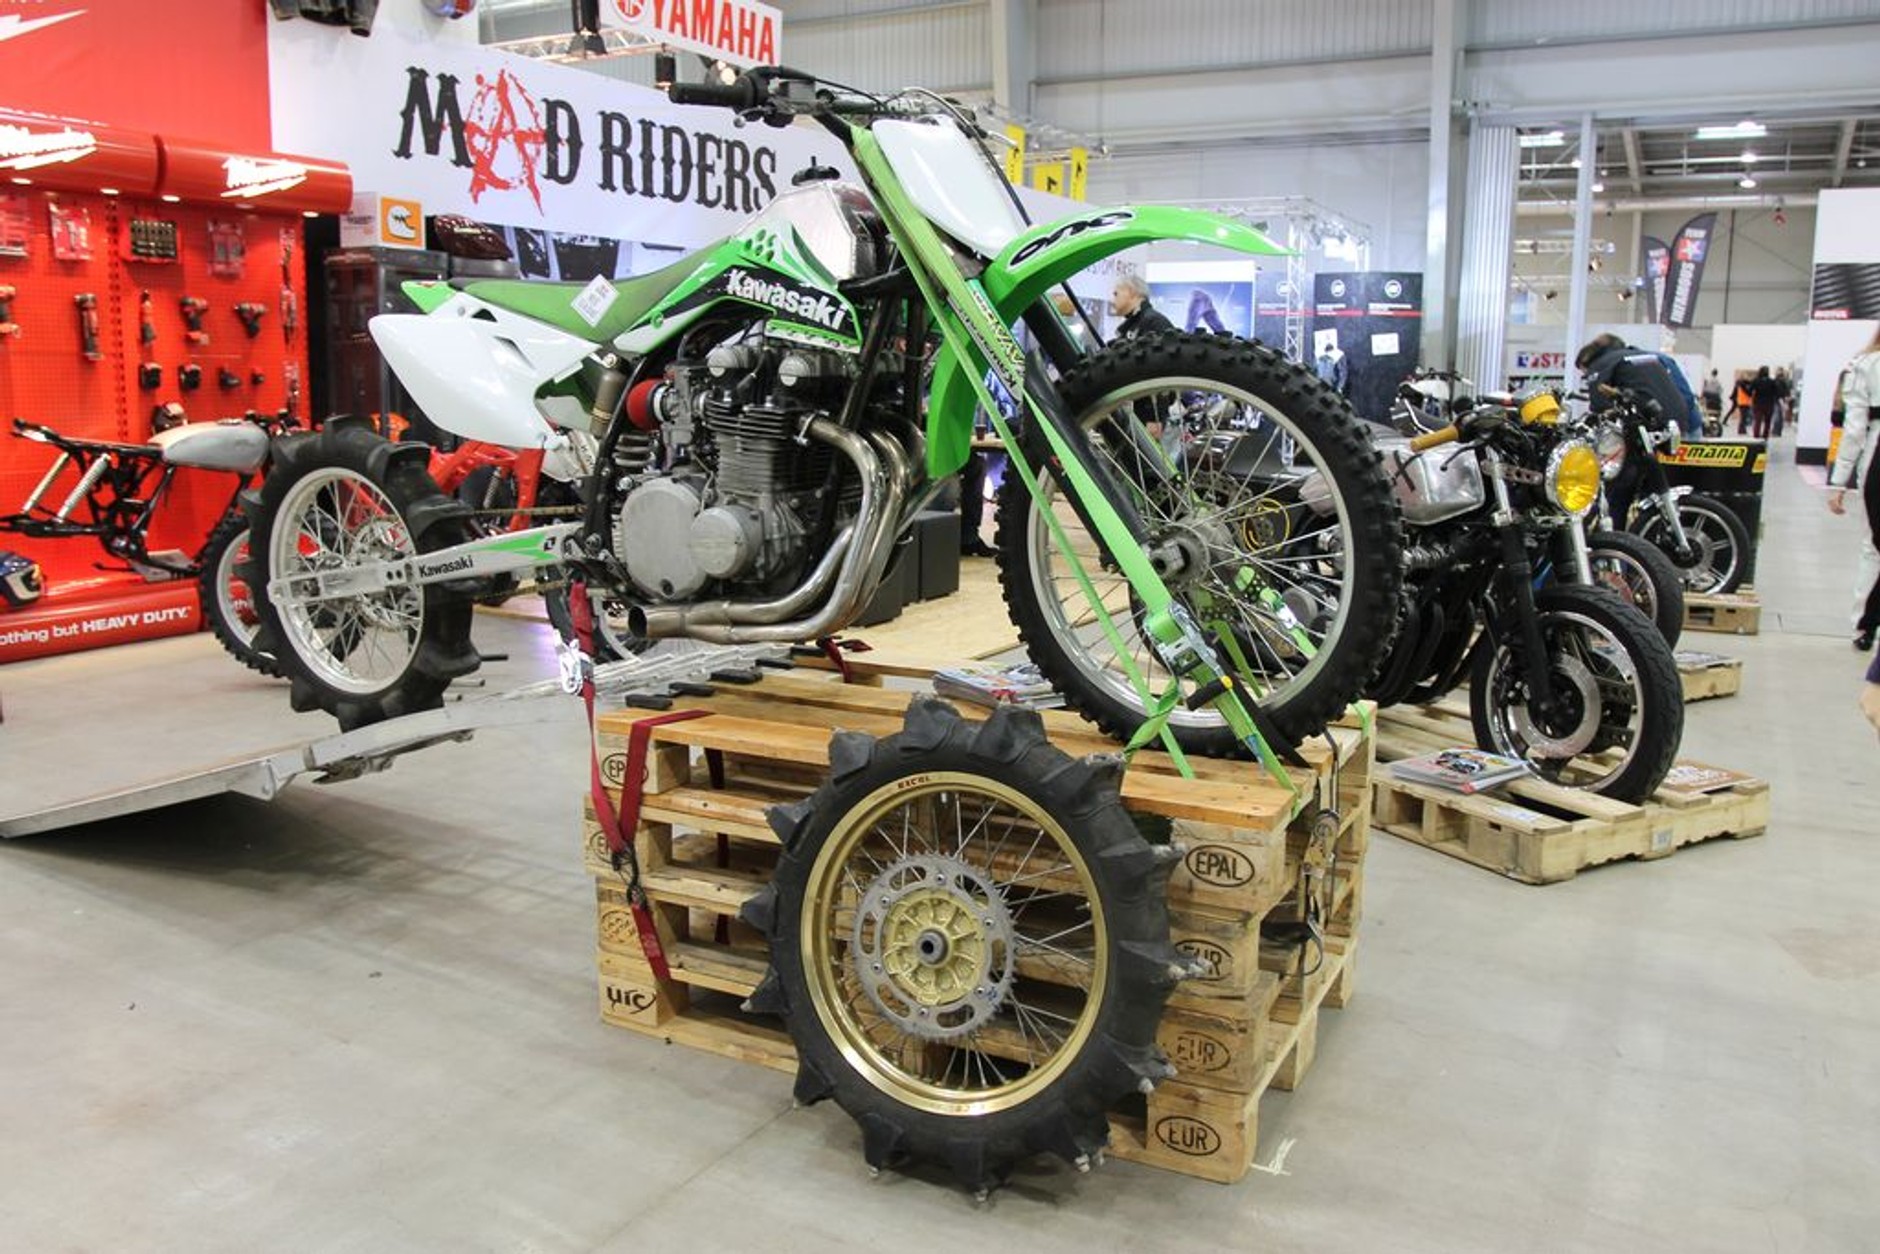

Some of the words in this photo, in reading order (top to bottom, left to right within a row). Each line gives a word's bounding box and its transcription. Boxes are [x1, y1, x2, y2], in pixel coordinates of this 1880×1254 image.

[651, 0, 775, 64] YAMAHA
[393, 61, 582, 218] MAD
[599, 110, 777, 214] RIDERS
[724, 267, 849, 331] Kawasaki
[419, 554, 475, 580] Kawasaki
[53, 622, 80, 638] but
[82, 613, 141, 634] HEAVY
[897, 774, 930, 789] EXCEL
[1195, 850, 1244, 881] EPAL
[1176, 1035, 1217, 1066] EUR
[1167, 1121, 1210, 1152] EUR
